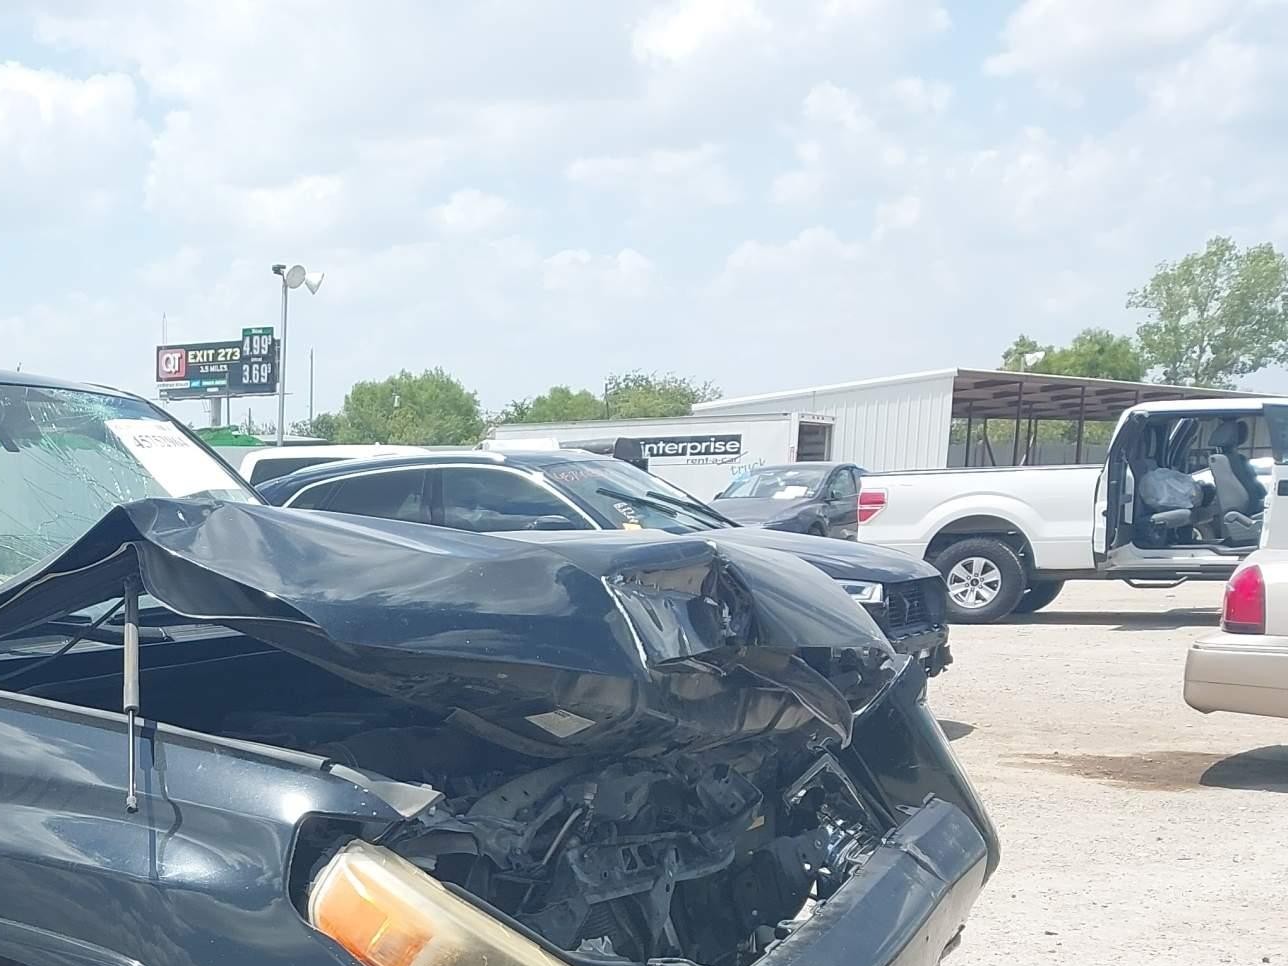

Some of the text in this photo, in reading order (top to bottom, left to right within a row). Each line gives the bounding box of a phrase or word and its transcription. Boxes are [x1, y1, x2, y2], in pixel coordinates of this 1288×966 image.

[163, 353, 182, 375] QT
[188, 348, 240, 363] EXIT 273
